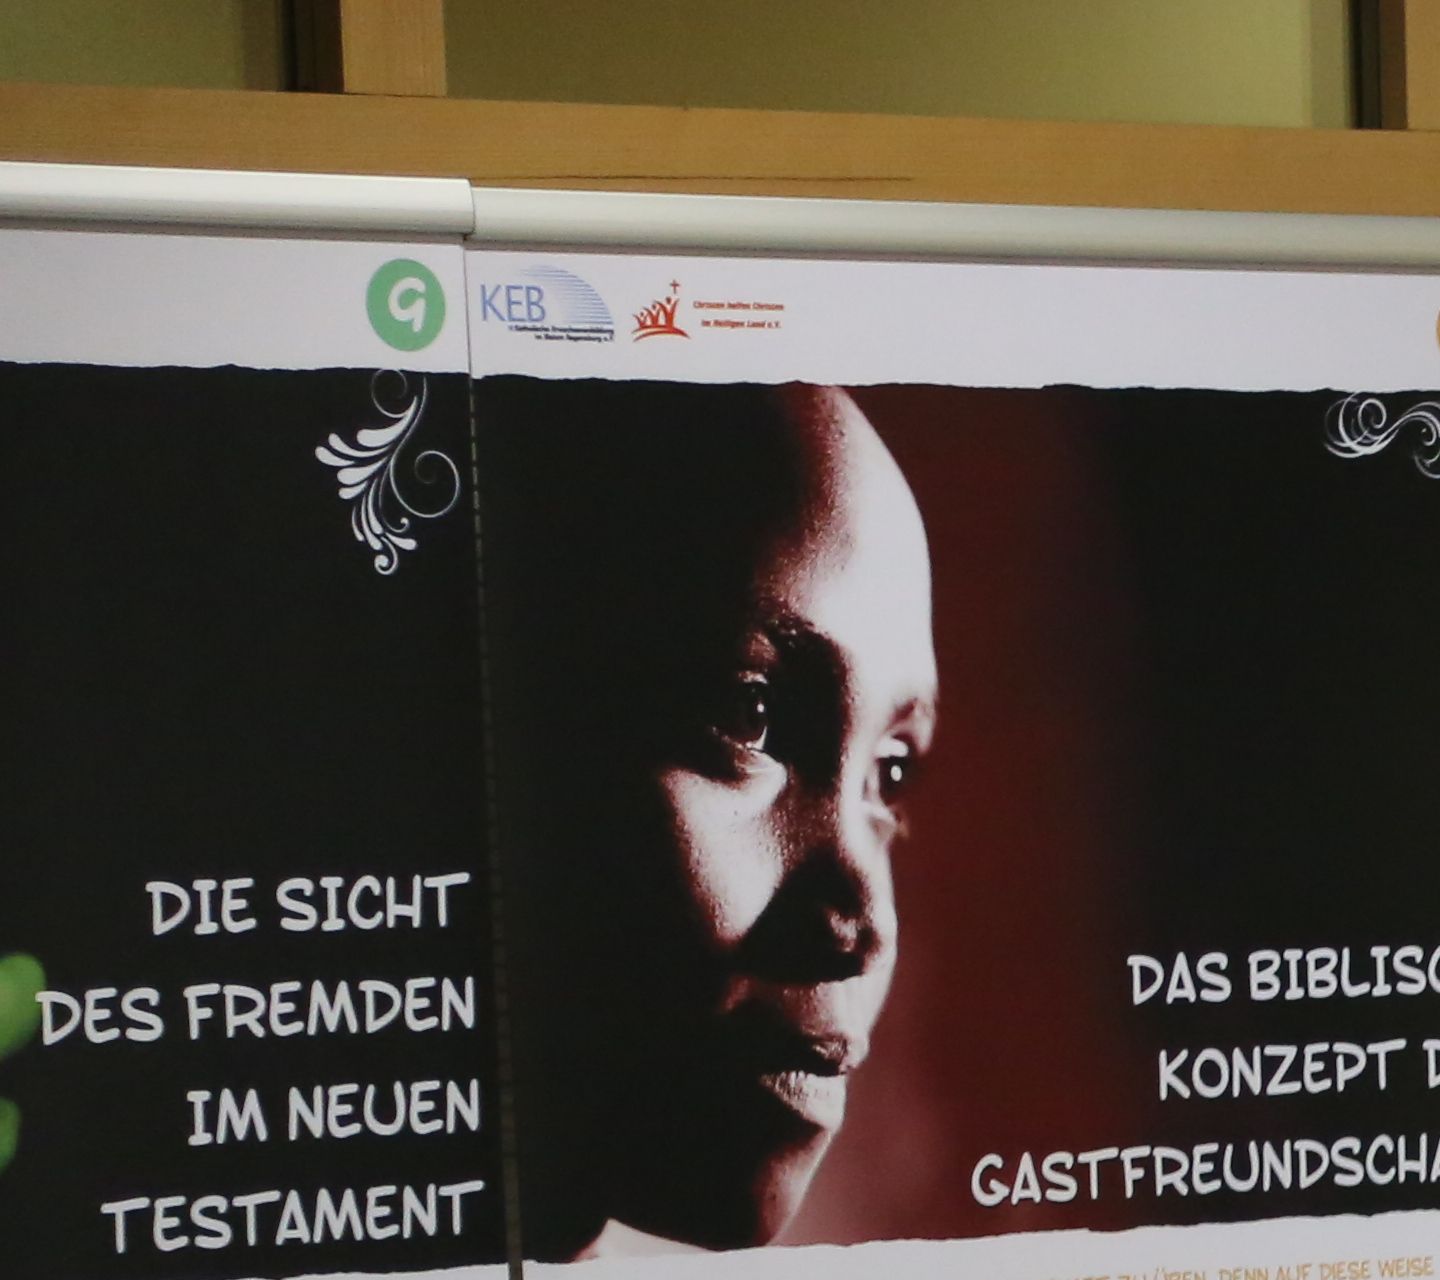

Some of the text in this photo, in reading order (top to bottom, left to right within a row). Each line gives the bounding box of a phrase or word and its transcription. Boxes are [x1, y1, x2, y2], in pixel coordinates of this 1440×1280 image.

[388, 278, 426, 333] 9
[480, 283, 546, 323] KEB
[145, 872, 470, 936] DIE SICHT
[1127, 952, 1232, 1005] DAS
[36, 976, 477, 1046] DES FREMDEN
[1158, 1038, 1406, 1100] KONZEPT
[187, 1079, 481, 1146] IM NEUEN
[100, 1179, 485, 1254] TESTAMENT
[1319, 1261, 1371, 1280] DIESE
[1377, 1257, 1434, 1277] WEISE
